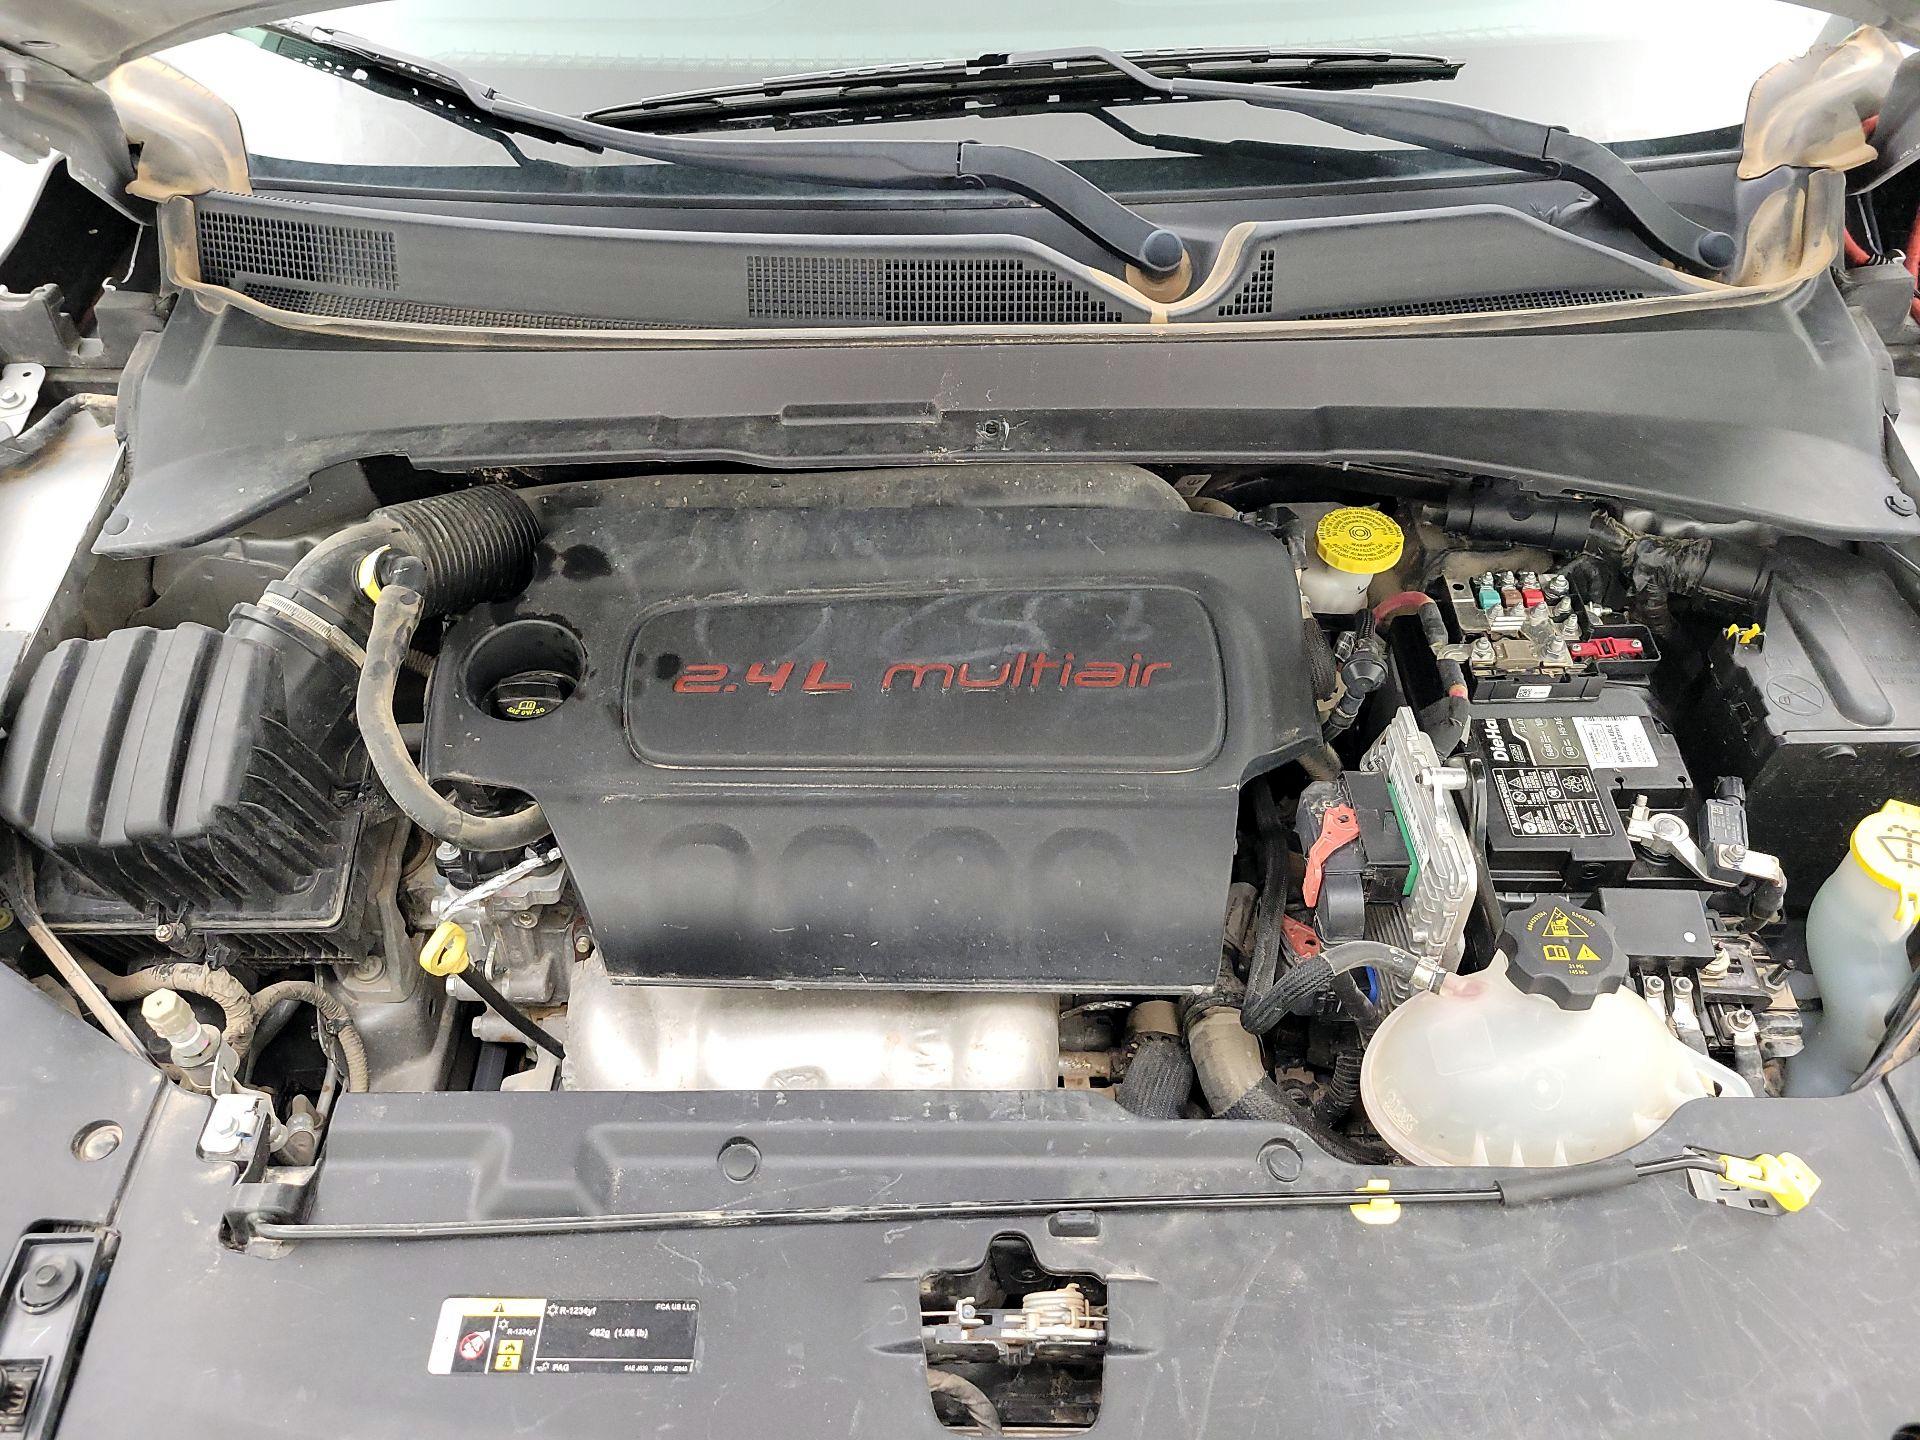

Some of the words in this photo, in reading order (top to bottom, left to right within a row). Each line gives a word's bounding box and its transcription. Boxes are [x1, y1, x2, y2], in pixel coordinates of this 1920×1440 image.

[880, 652, 1173, 691] multiair
[506, 706, 520, 715] SAE
[521, 707, 546, 716] 0W-20
[559, 1306, 597, 1316] R-1234yf
[655, 1303, 671, 1311] FCA
[682, 1303, 697, 1311] LLC
[506, 1328, 537, 1336] R-1234yf
[636, 1328, 649, 1339] lb)
[552, 1362, 570, 1372] PAG
